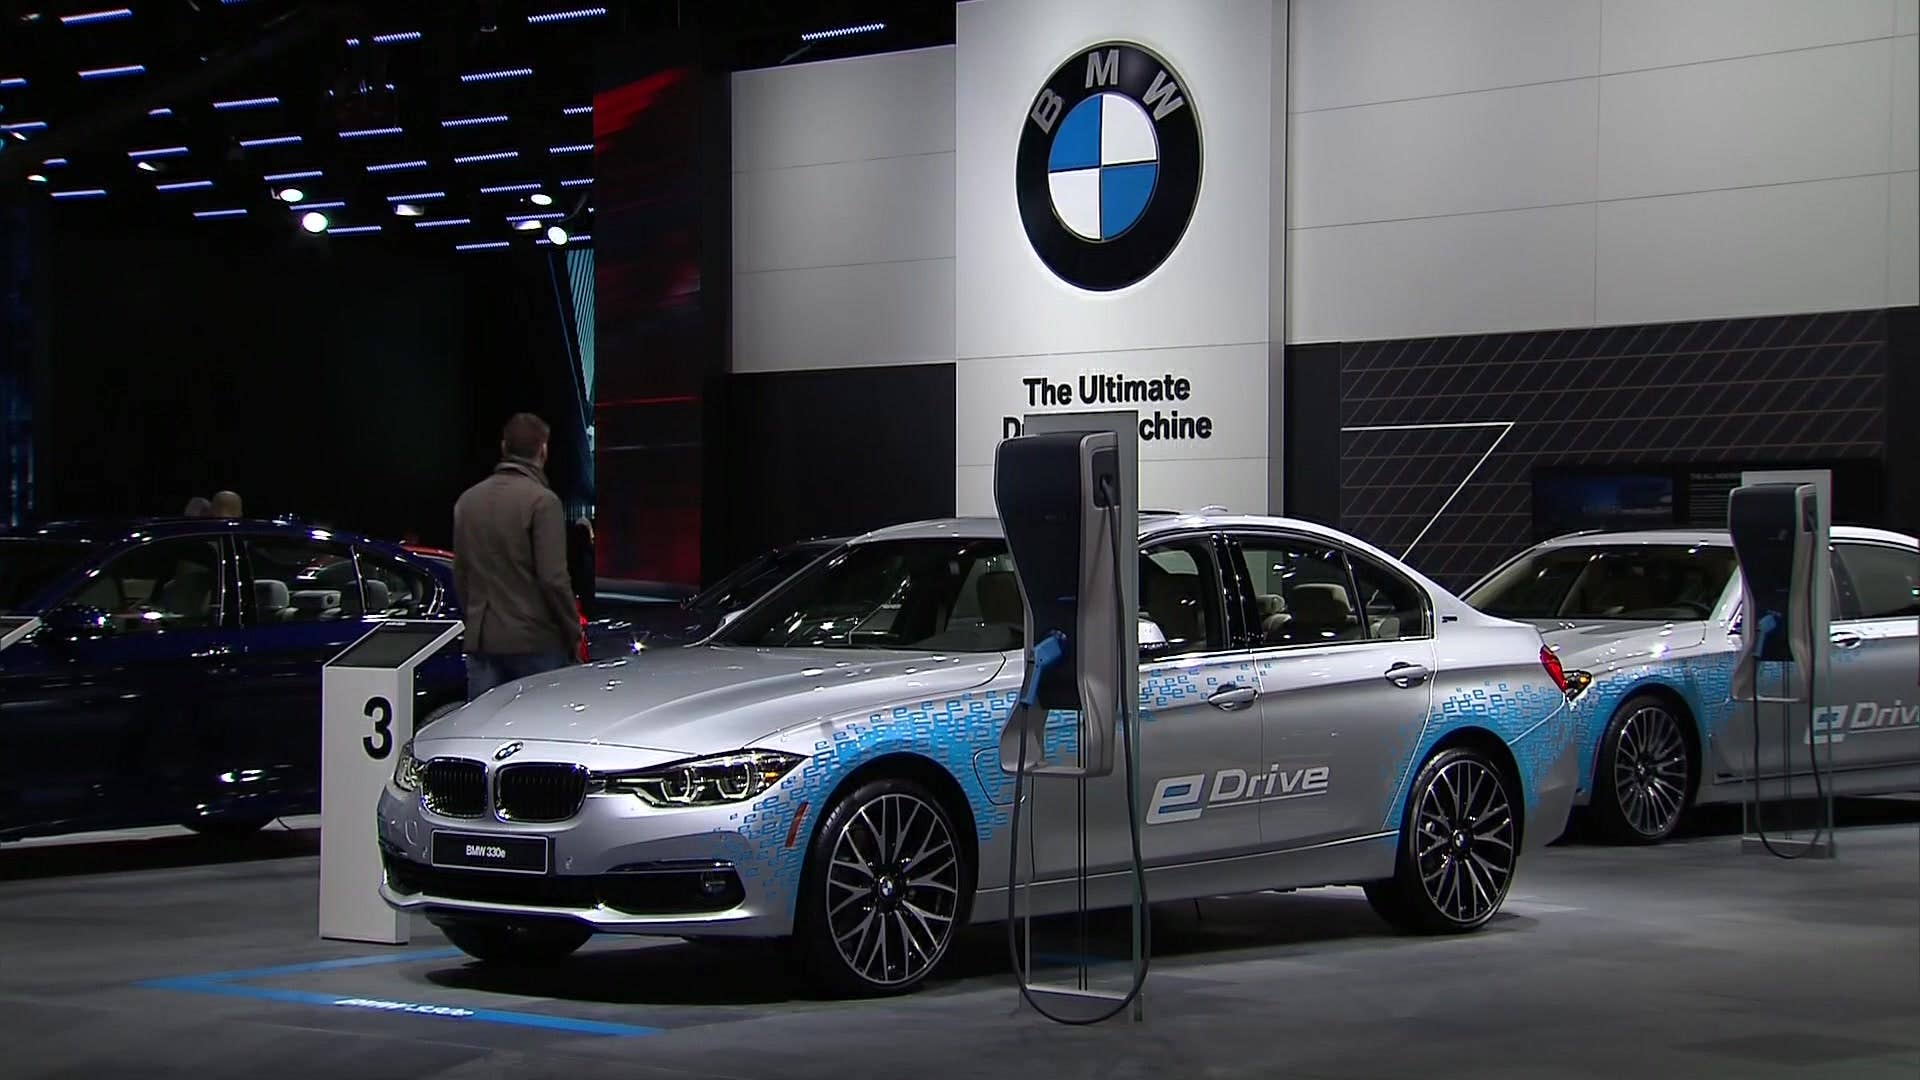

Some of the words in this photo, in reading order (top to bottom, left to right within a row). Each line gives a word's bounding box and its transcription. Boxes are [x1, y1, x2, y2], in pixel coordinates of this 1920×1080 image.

[1031, 49, 1185, 134] BMW
[1023, 377, 1072, 406] The
[1079, 374, 1190, 404] Ultimate
[1139, 410, 1212, 440] chine
[363, 696, 393, 760] 3
[1804, 700, 1920, 744] eDriv
[466, 845, 486, 856] BMW
